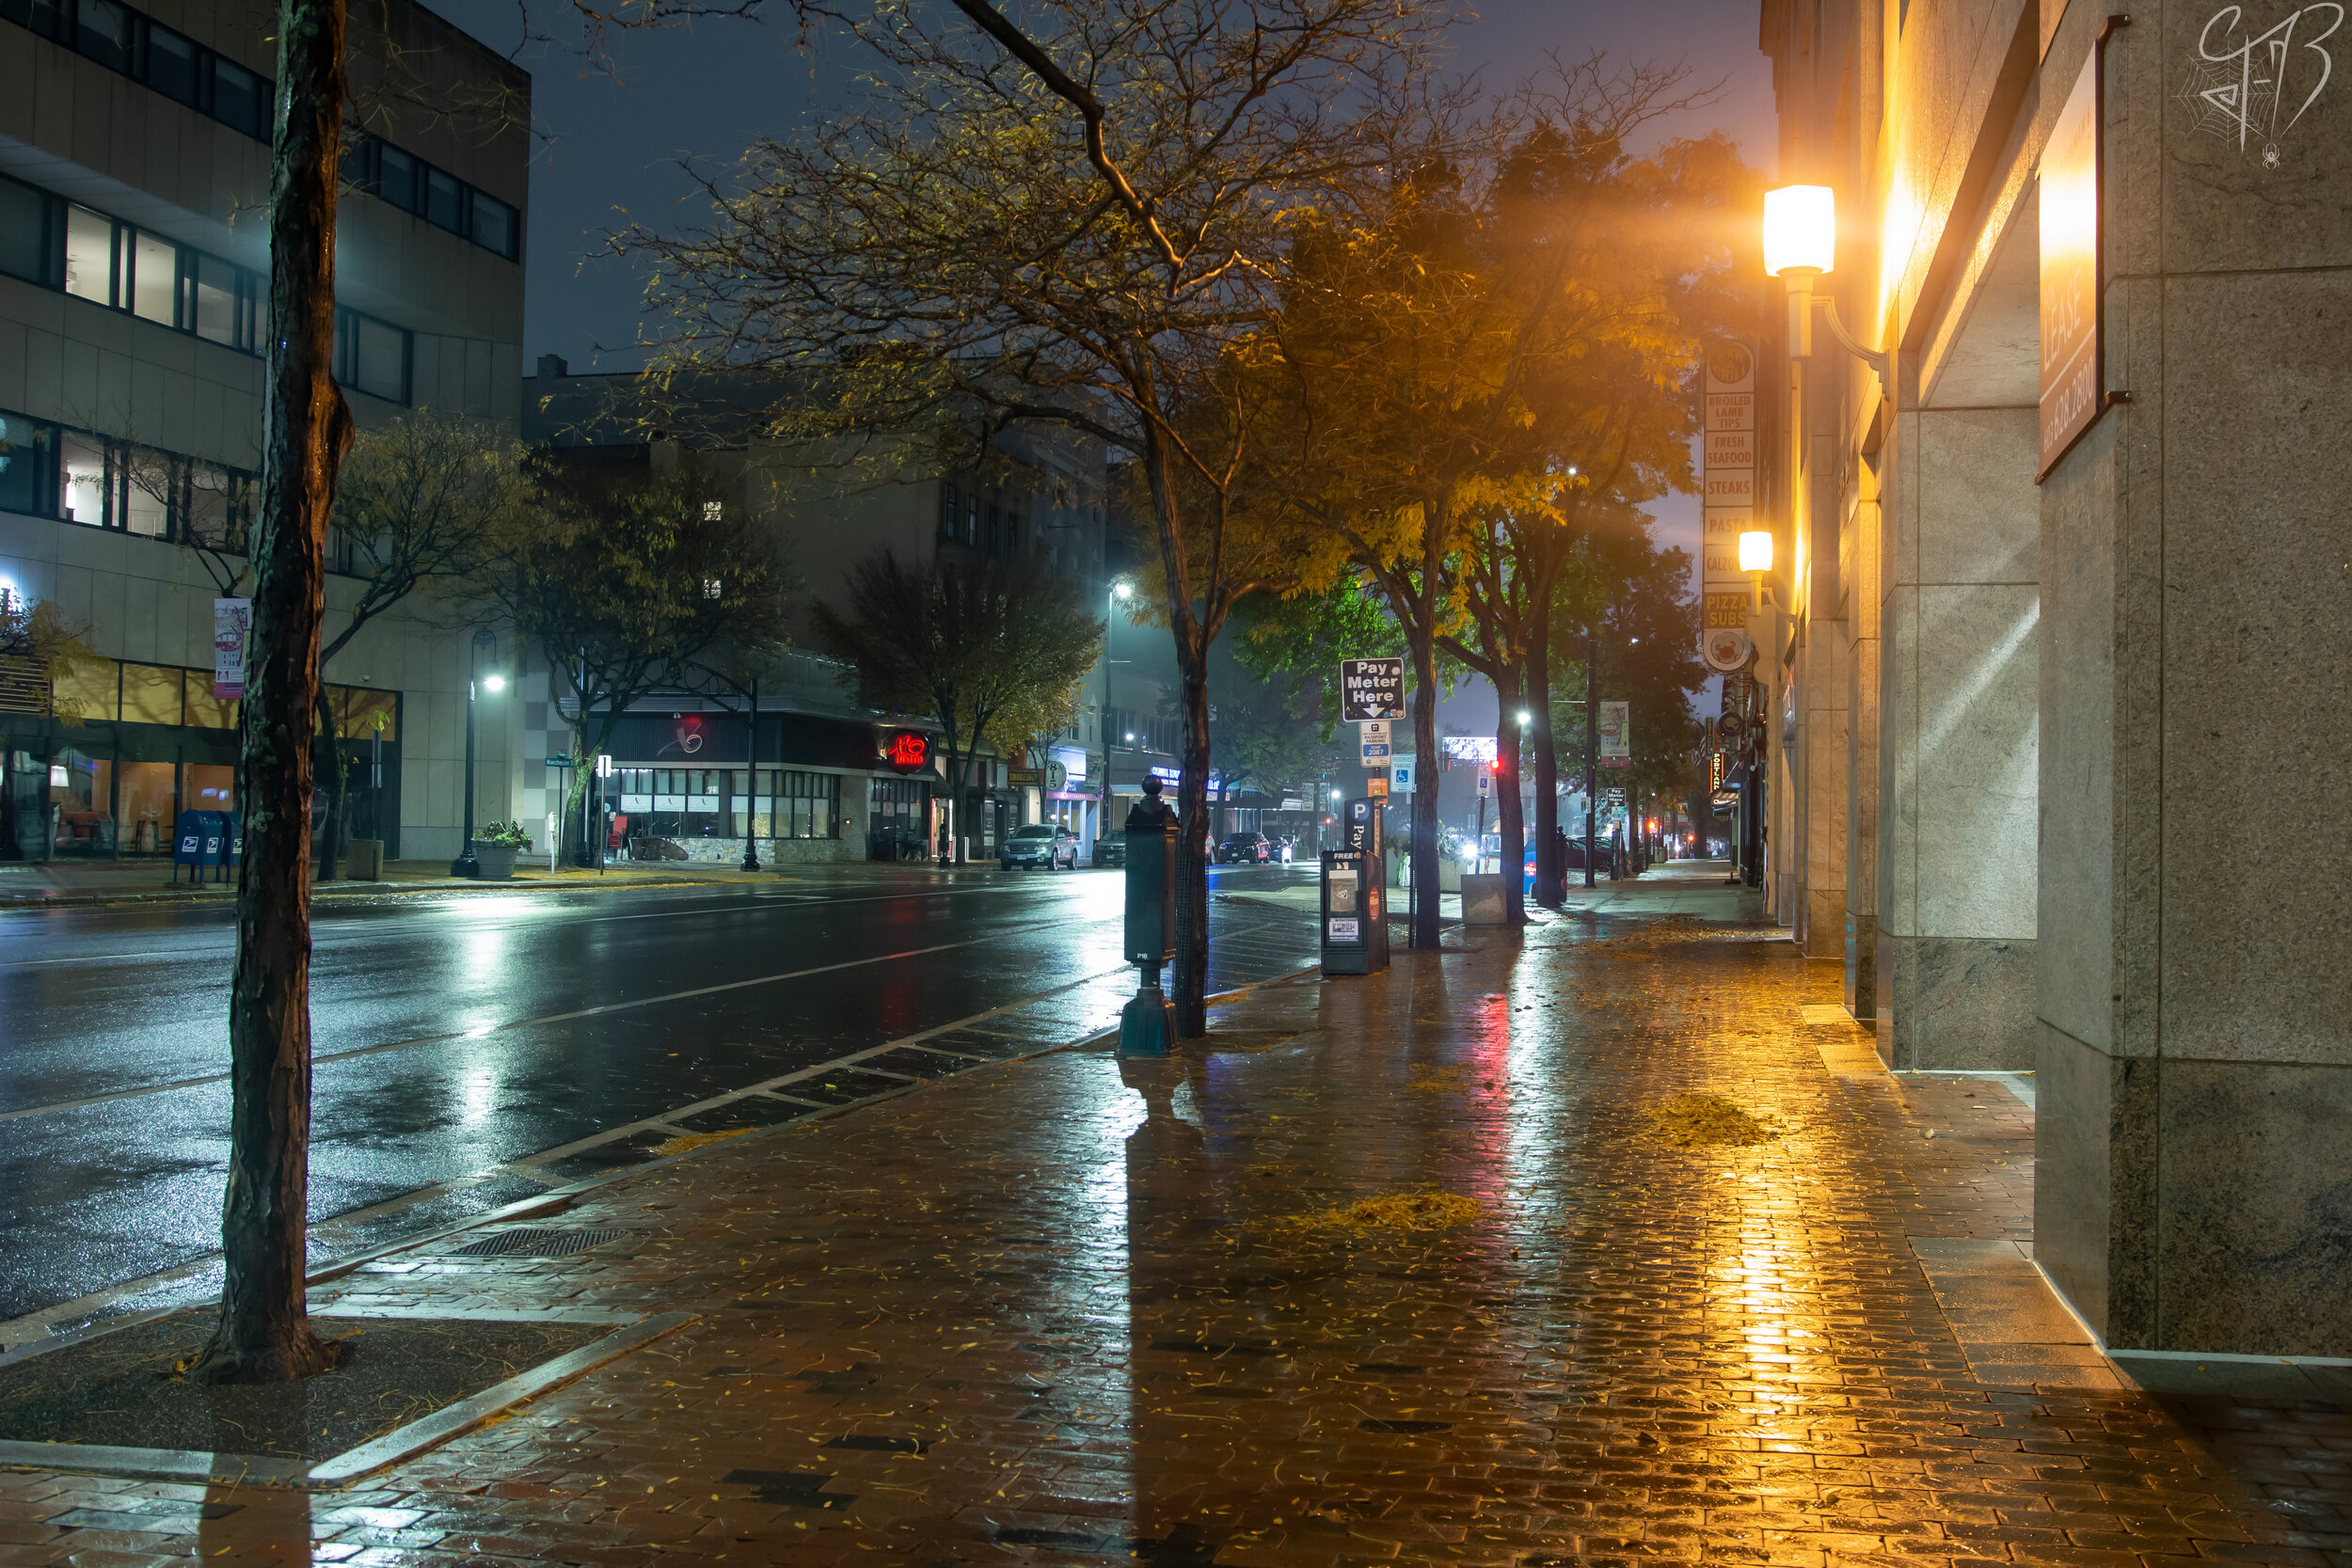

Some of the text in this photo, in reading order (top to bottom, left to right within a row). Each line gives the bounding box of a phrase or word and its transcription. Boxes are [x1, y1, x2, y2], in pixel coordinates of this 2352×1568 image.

[2043, 265, 2081, 372] LEASE
[1708, 395, 1751, 406] BROILED
[2054, 355, 2093, 441] 628.2800
[1715, 407, 1744, 418] LAMB
[1718, 419, 1740, 429] TIPS
[1714, 436, 1745, 448] FRESH
[1708, 451, 1752, 465] SEAFOOD
[1708, 481, 1750, 495] STEAKS
[1708, 518, 1748, 533] PASTA
[1707, 594, 1748, 610] PIZZA
[1708, 610, 1747, 626] SUBS
[1357, 661, 1388, 676] Pay
[1347, 676, 1399, 689] Meter
[1353, 690, 1394, 704] Here
[1049, 763, 1057, 788] 815
[1354, 803, 1366, 819] P
[1350, 825, 1364, 850] Pay
